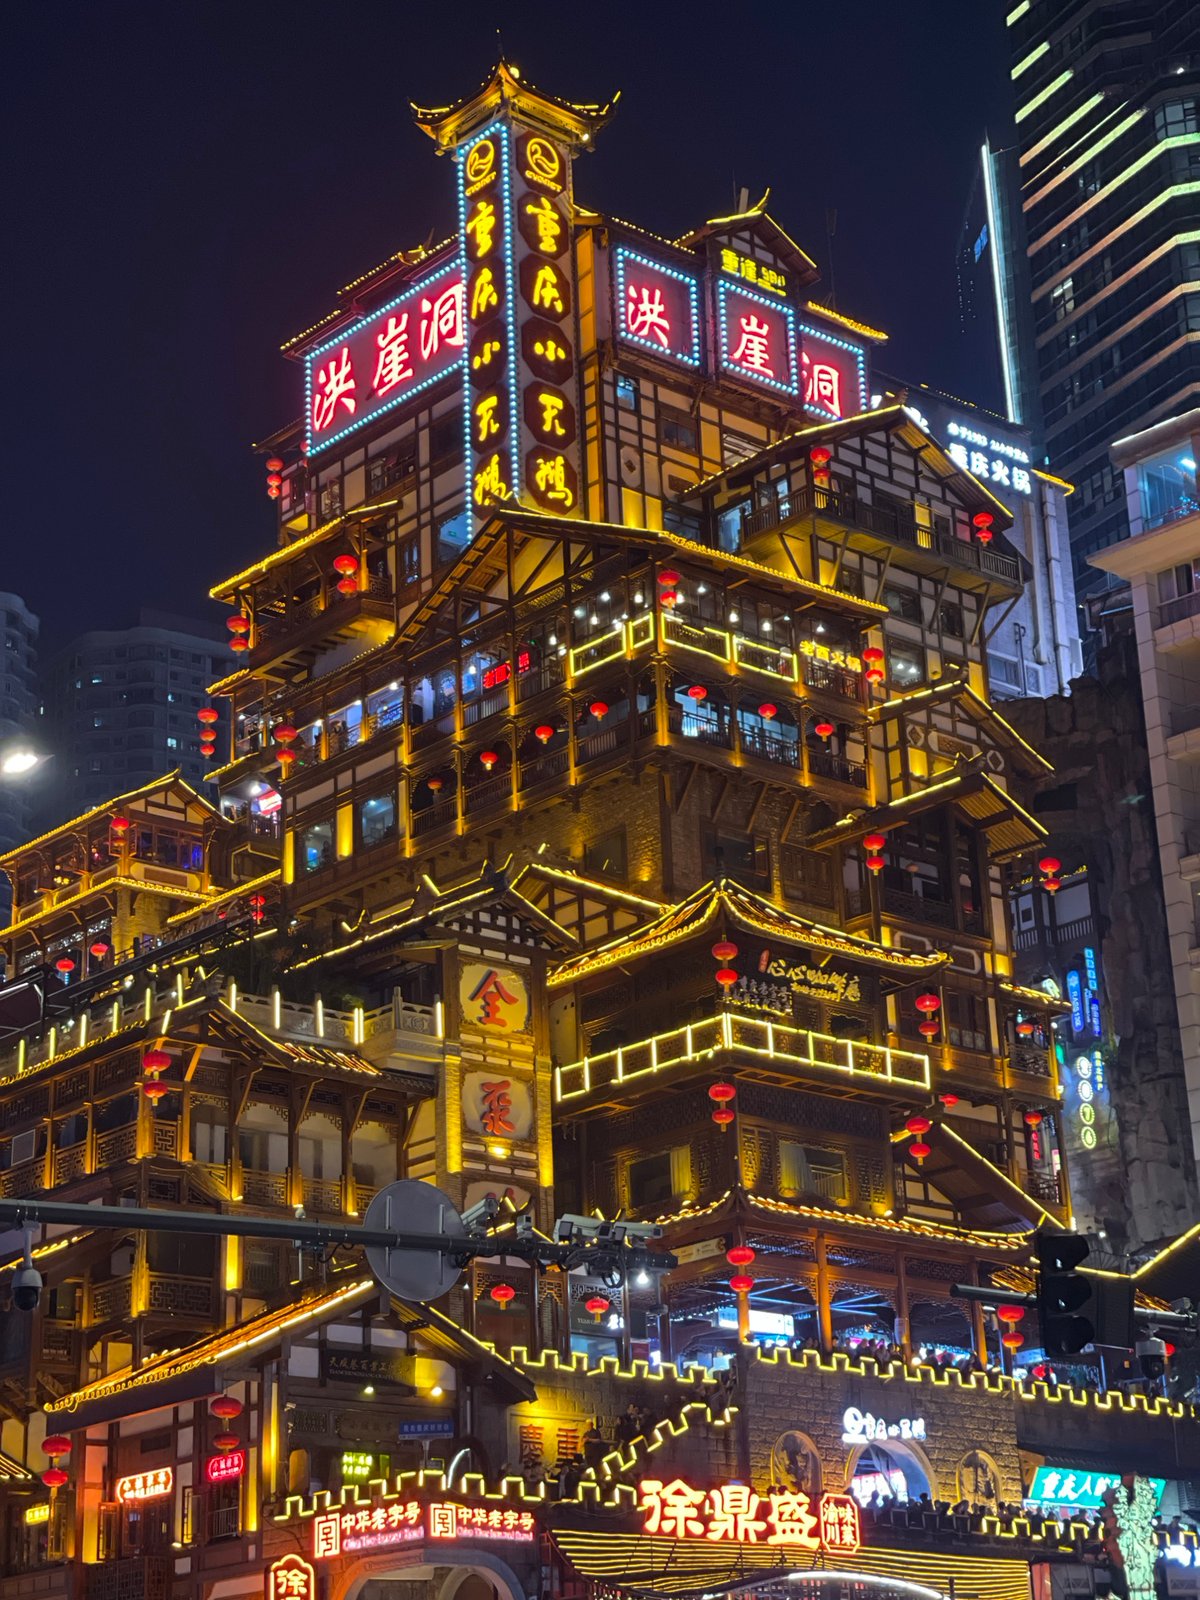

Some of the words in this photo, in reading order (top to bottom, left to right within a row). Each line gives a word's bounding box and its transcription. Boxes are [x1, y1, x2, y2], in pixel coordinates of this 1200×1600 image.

[313, 282, 466, 431] 洪崖洞
[627, 284, 842, 417] 洪崖洞
[341, 1501, 421, 1535] 中华老字号
[457, 1507, 535, 1531] 中华老字号
[639, 1478, 821, 1550] 徐鼎盛
[276, 1568, 309, 1600] 徐
